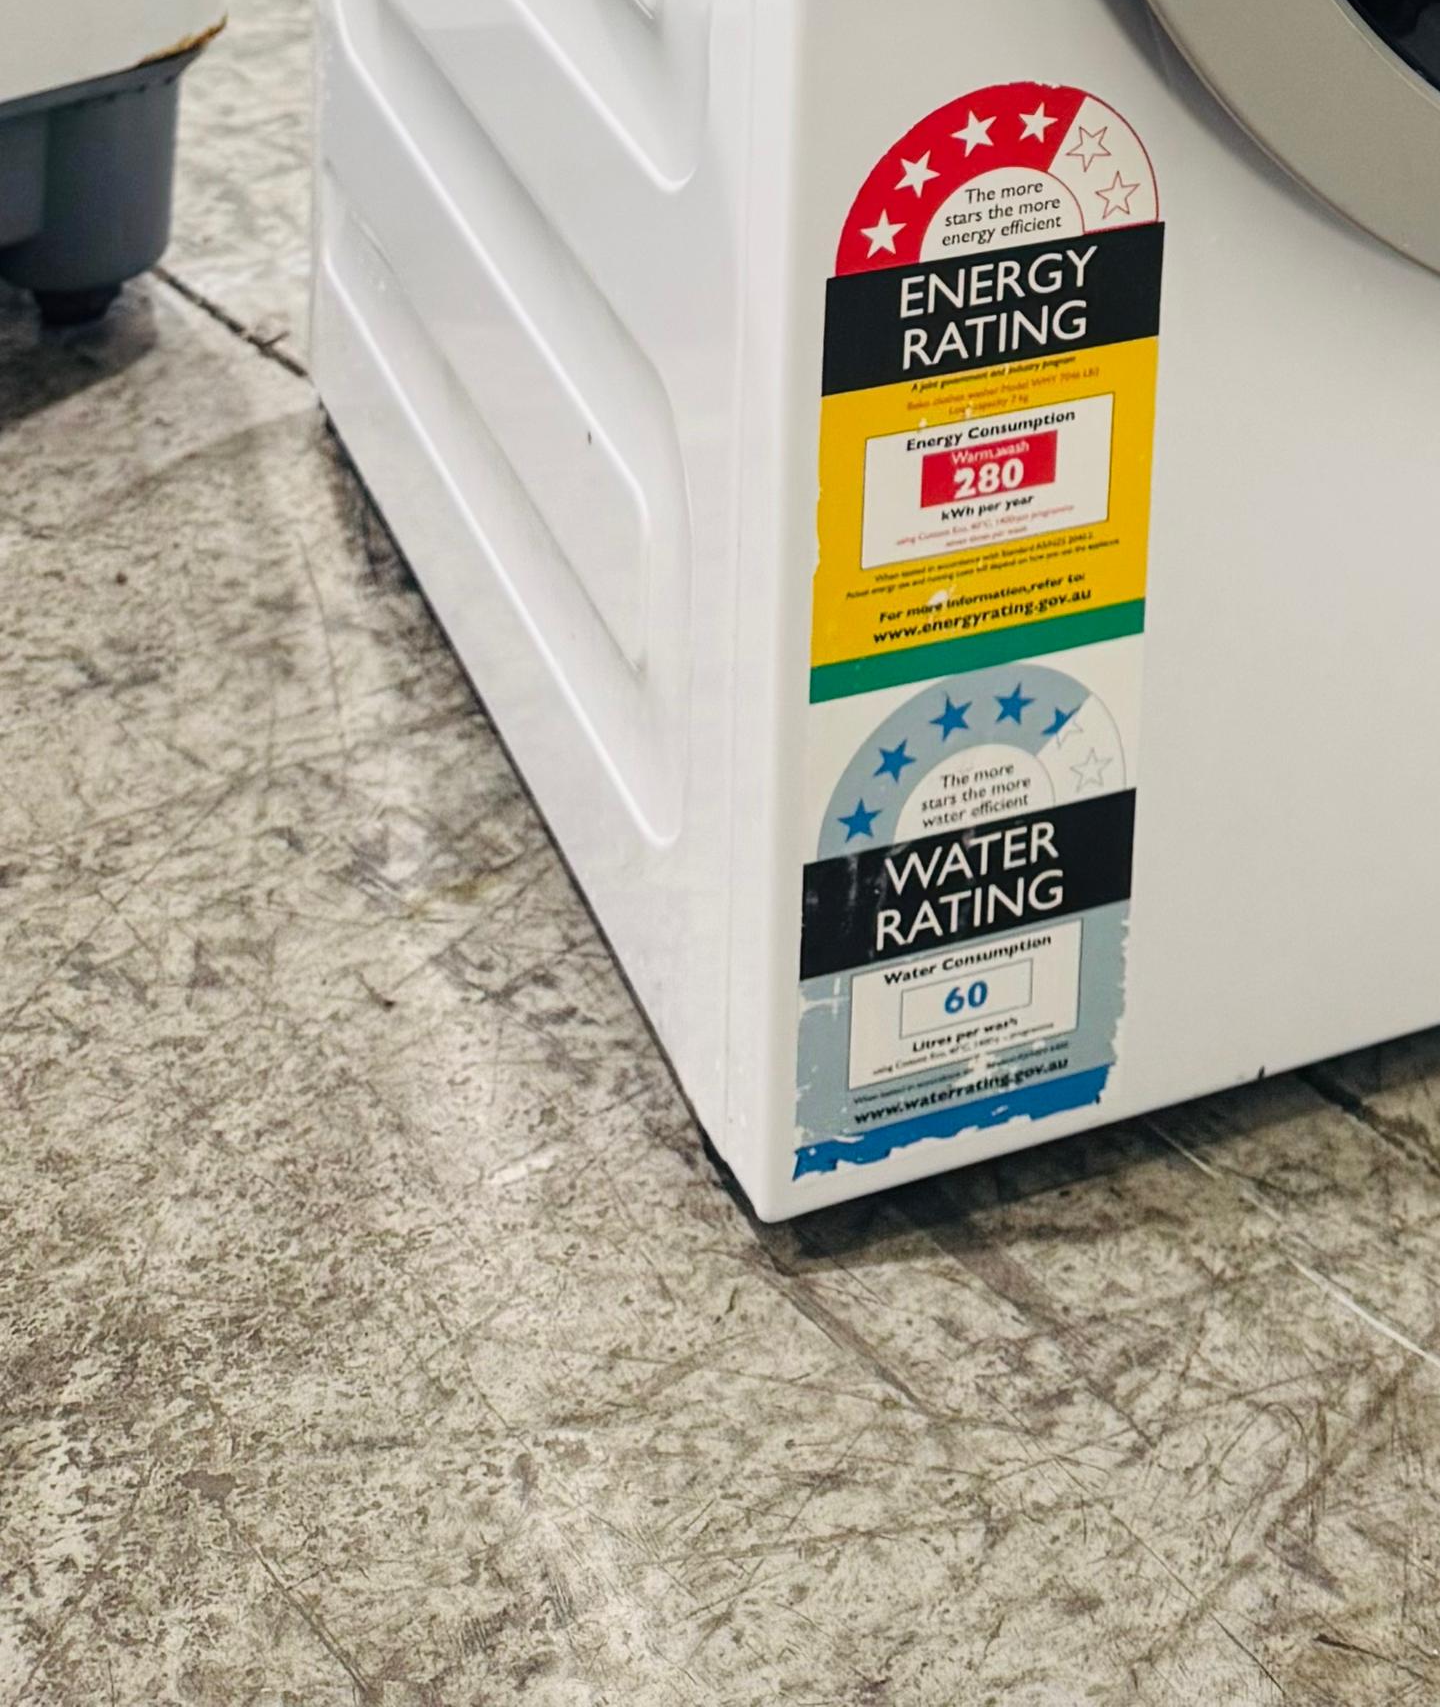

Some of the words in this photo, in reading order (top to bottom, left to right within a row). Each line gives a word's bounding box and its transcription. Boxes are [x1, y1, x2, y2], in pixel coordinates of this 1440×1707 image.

[945, 209, 982, 227] stars
[988, 204, 1014, 220] the
[1019, 196, 1061, 216] more
[966, 187, 996, 204] The
[1001, 181, 1043, 201] more
[942, 226, 995, 247] energy
[1000, 215, 1062, 237] efficient
[900, 245, 1098, 319] ENERGY
[902, 299, 1087, 371] RATING
[906, 432, 963, 452] Energy
[968, 410, 1076, 438] Consumption
[954, 458, 1024, 499] 280
[941, 504, 975, 522] kWh
[978, 501, 1001, 517] per
[1005, 494, 1035, 513] year
[873, 588, 1092, 643] www.energyrating.gov.au
[880, 610, 903, 623] For
[907, 602, 943, 617] more
[1067, 573, 1085, 592] to:
[921, 794, 958, 811] stars
[962, 785, 987, 803] the
[991, 776, 1031, 795] more
[940, 773, 971, 789] The
[974, 764, 1015, 782] more
[922, 811, 964, 829] water
[971, 794, 1029, 819] efficient
[885, 822, 1060, 895] WATER
[876, 869, 1064, 952] RATING
[884, 963, 937, 986] Water
[942, 934, 1052, 971] Consumption
[944, 981, 988, 1014] 60
[912, 1036, 951, 1052] Litres
[956, 1027, 979, 1044] per
[985, 1017, 1018, 1032] wash
[854, 1058, 1069, 1124] www.waterrating.gov.au
